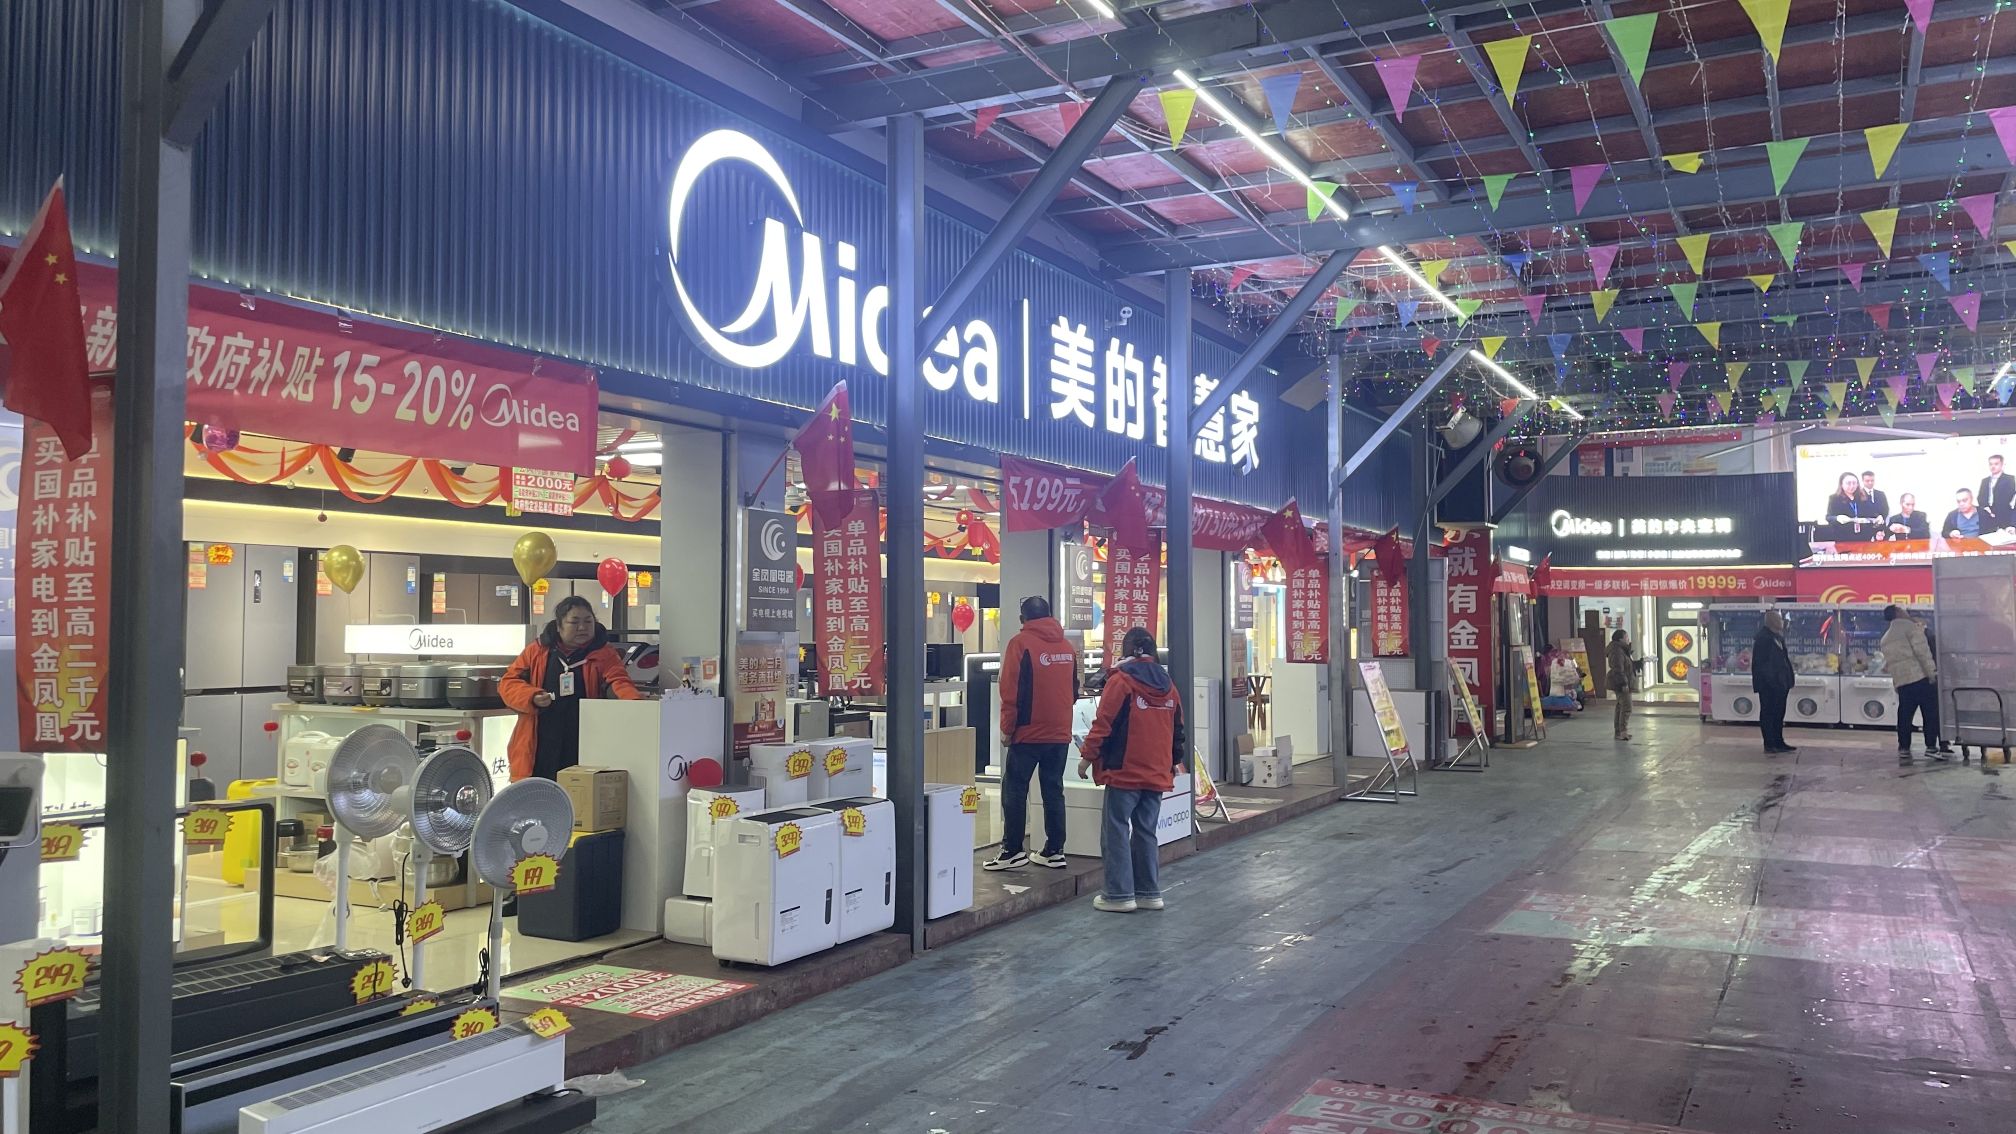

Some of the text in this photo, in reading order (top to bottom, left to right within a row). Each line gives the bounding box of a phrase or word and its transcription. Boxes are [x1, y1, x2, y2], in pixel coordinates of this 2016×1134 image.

[186, 326, 324, 402] 政府补贴
[332, 350, 476, 430] 15-20%
[481, 384, 579, 432] Midea
[1551, 509, 1613, 537] Midea
[752, 568, 794, 583] 金凤凰电器
[1753, 576, 1792, 590] Midea
[758, 586, 776, 594] SINCE
[847, 519, 872, 690] 单品补贴至高二千元
[409, 628, 454, 650] Midea
